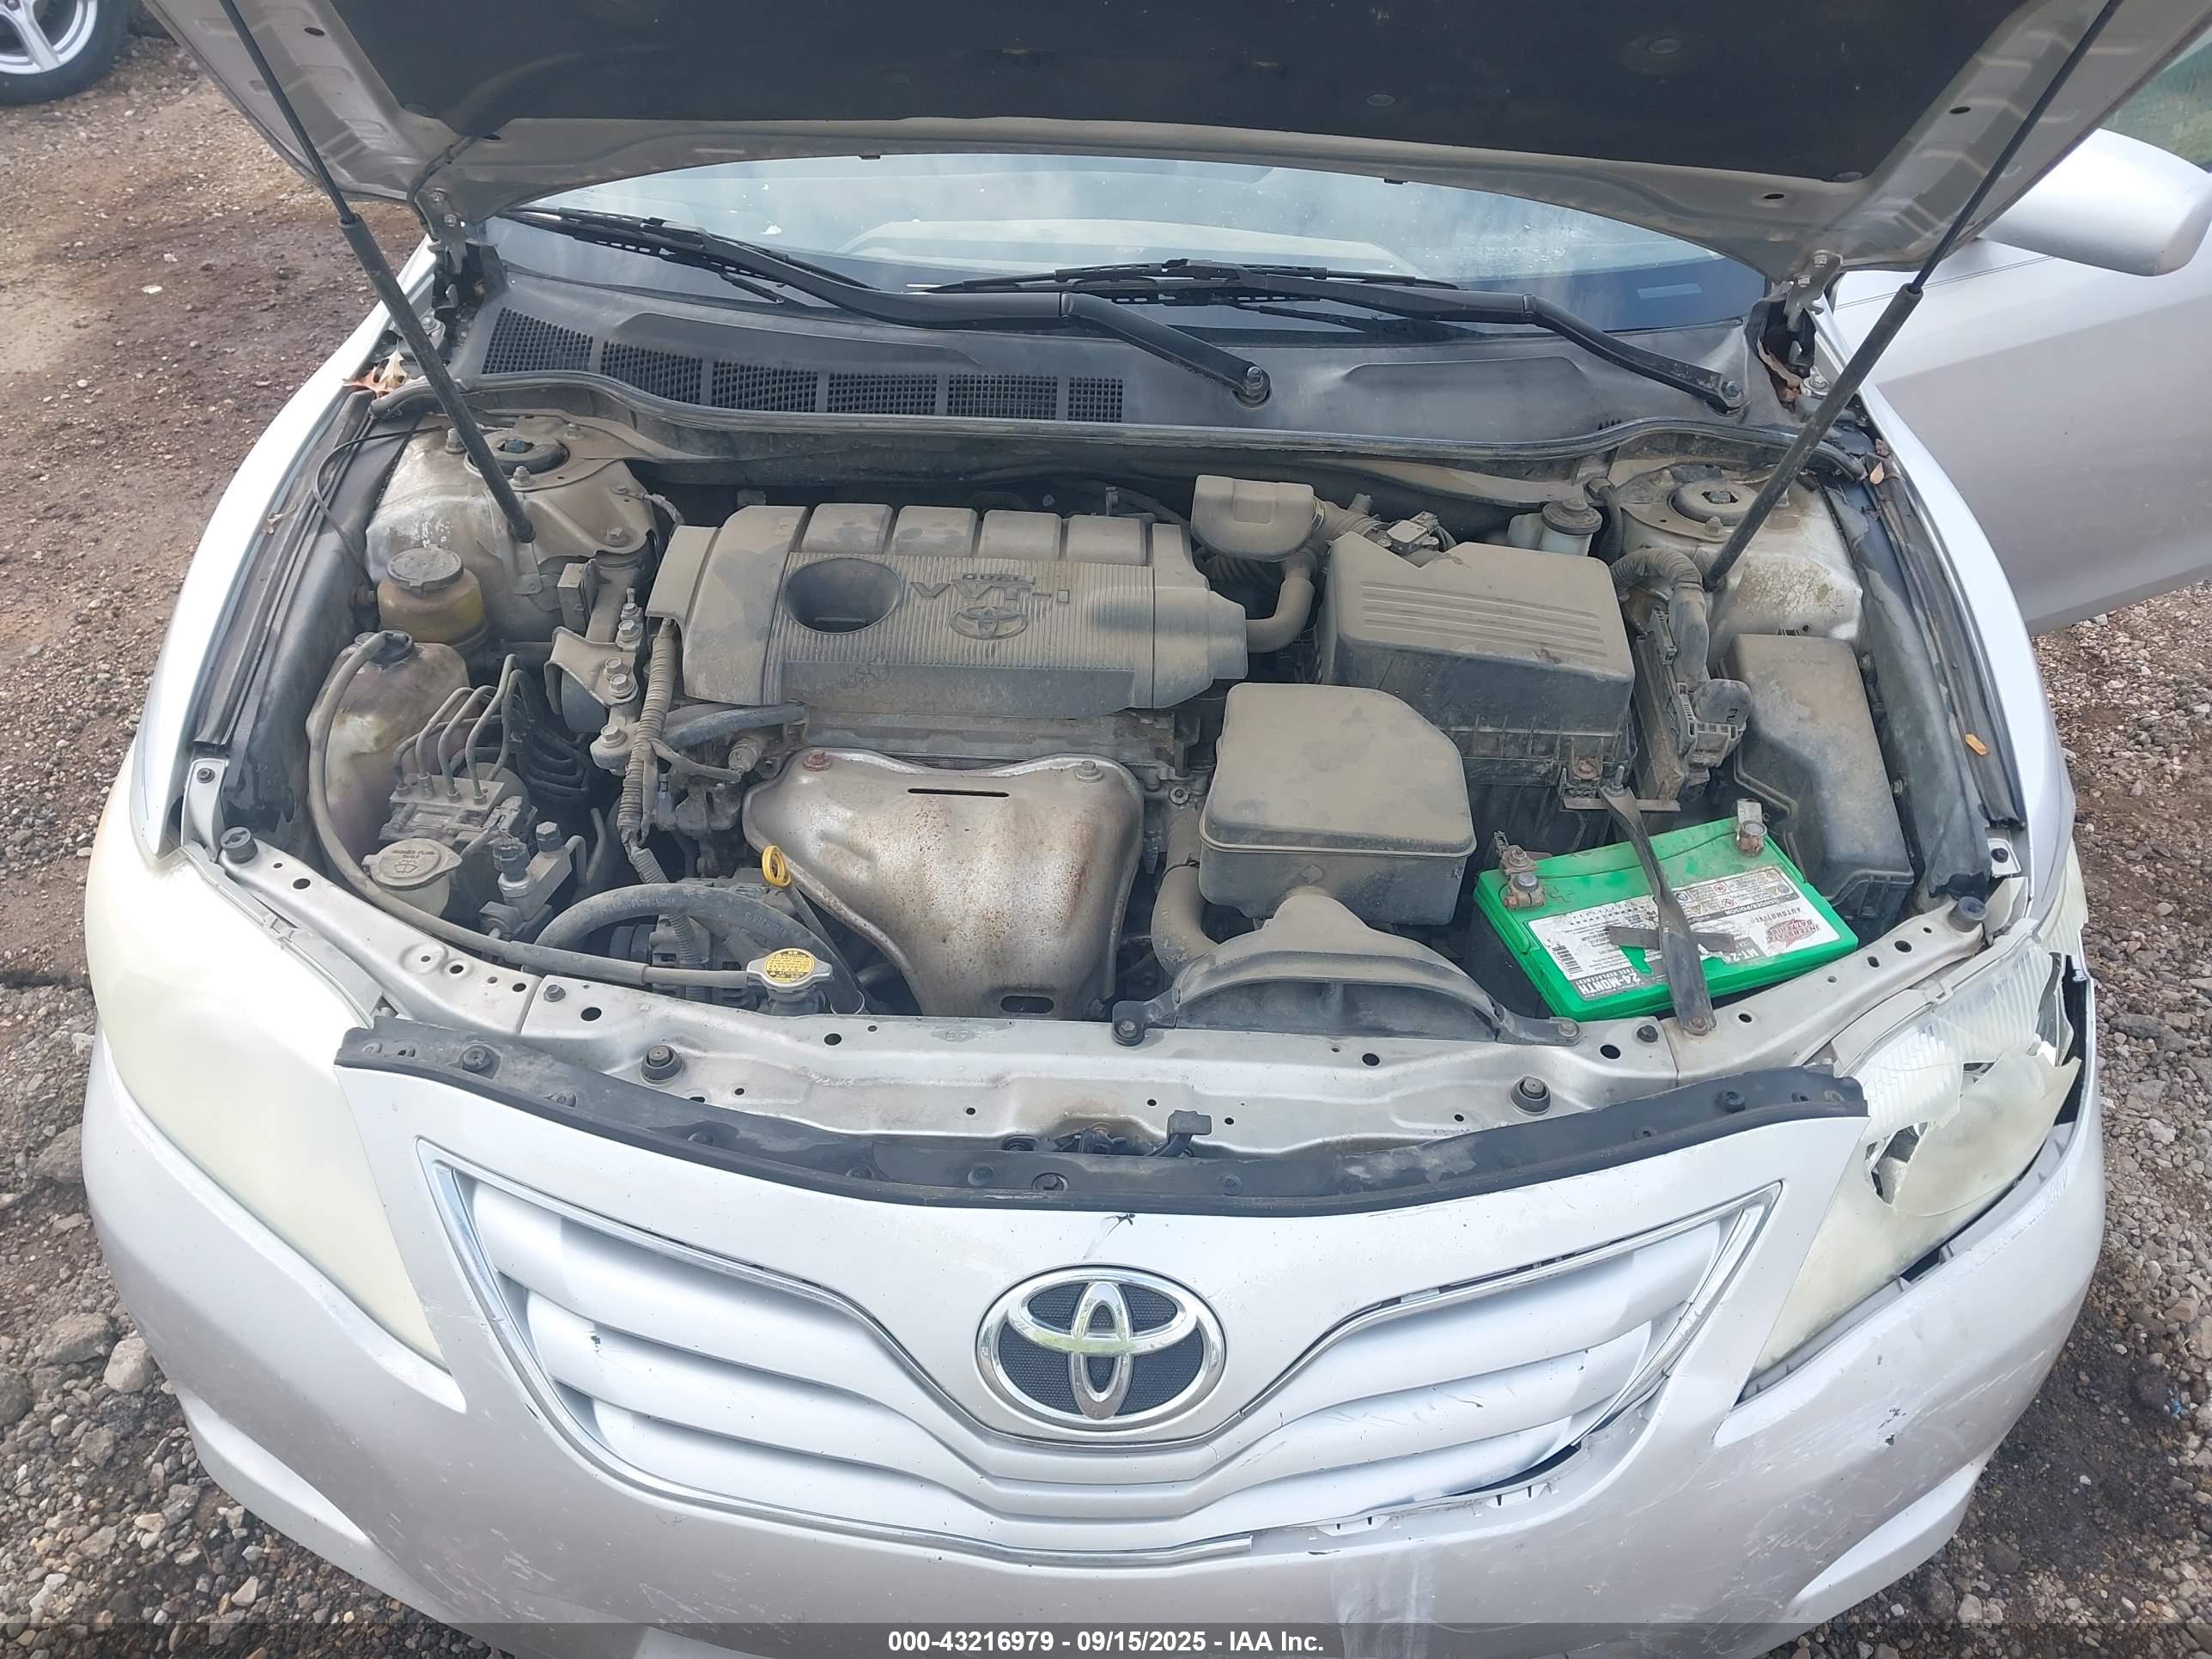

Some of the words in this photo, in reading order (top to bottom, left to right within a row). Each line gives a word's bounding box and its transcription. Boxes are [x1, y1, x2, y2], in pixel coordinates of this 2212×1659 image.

[1754, 906, 1802, 923] AUTOMOTIVE
[1765, 918, 1814, 936] BATTERIES
[1765, 925, 1821, 945] INTERSTATE
[1574, 971, 1618, 986] REPLACEMENT
[1577, 971, 1642, 995] 24-MONTH
